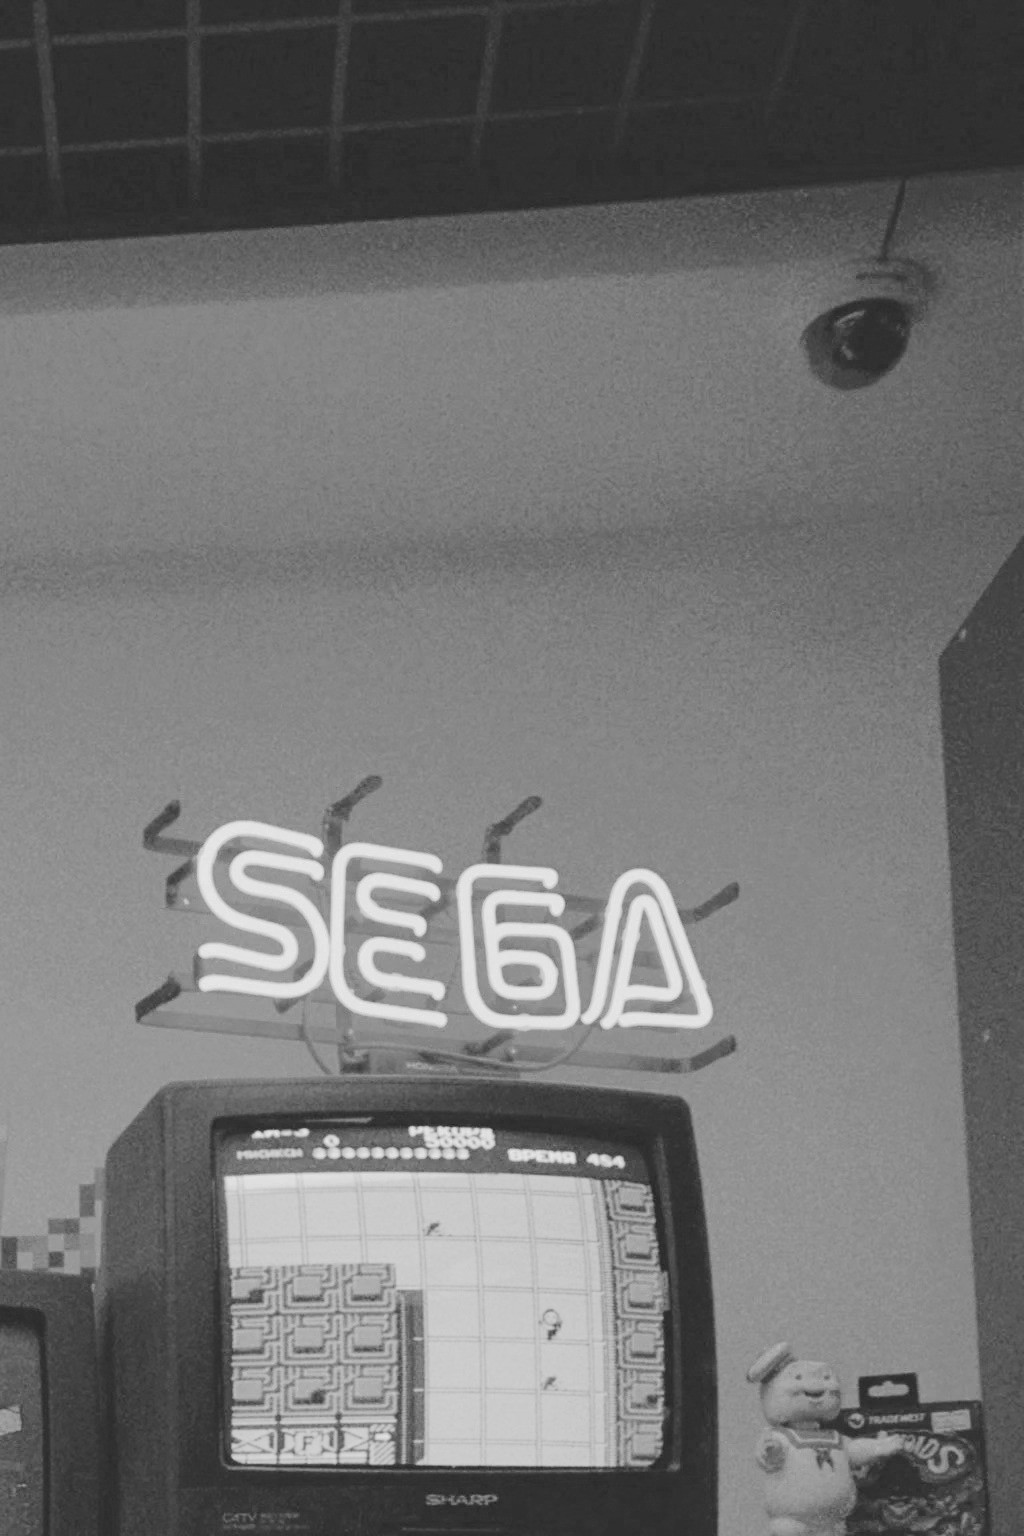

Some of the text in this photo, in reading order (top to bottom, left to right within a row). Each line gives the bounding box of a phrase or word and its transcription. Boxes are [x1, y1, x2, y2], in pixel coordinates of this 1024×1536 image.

[196, 820, 714, 1031] SEGA
[507, 1147, 577, 1165] ВРЕМЯ
[424, 1492, 500, 1508] SHARP
